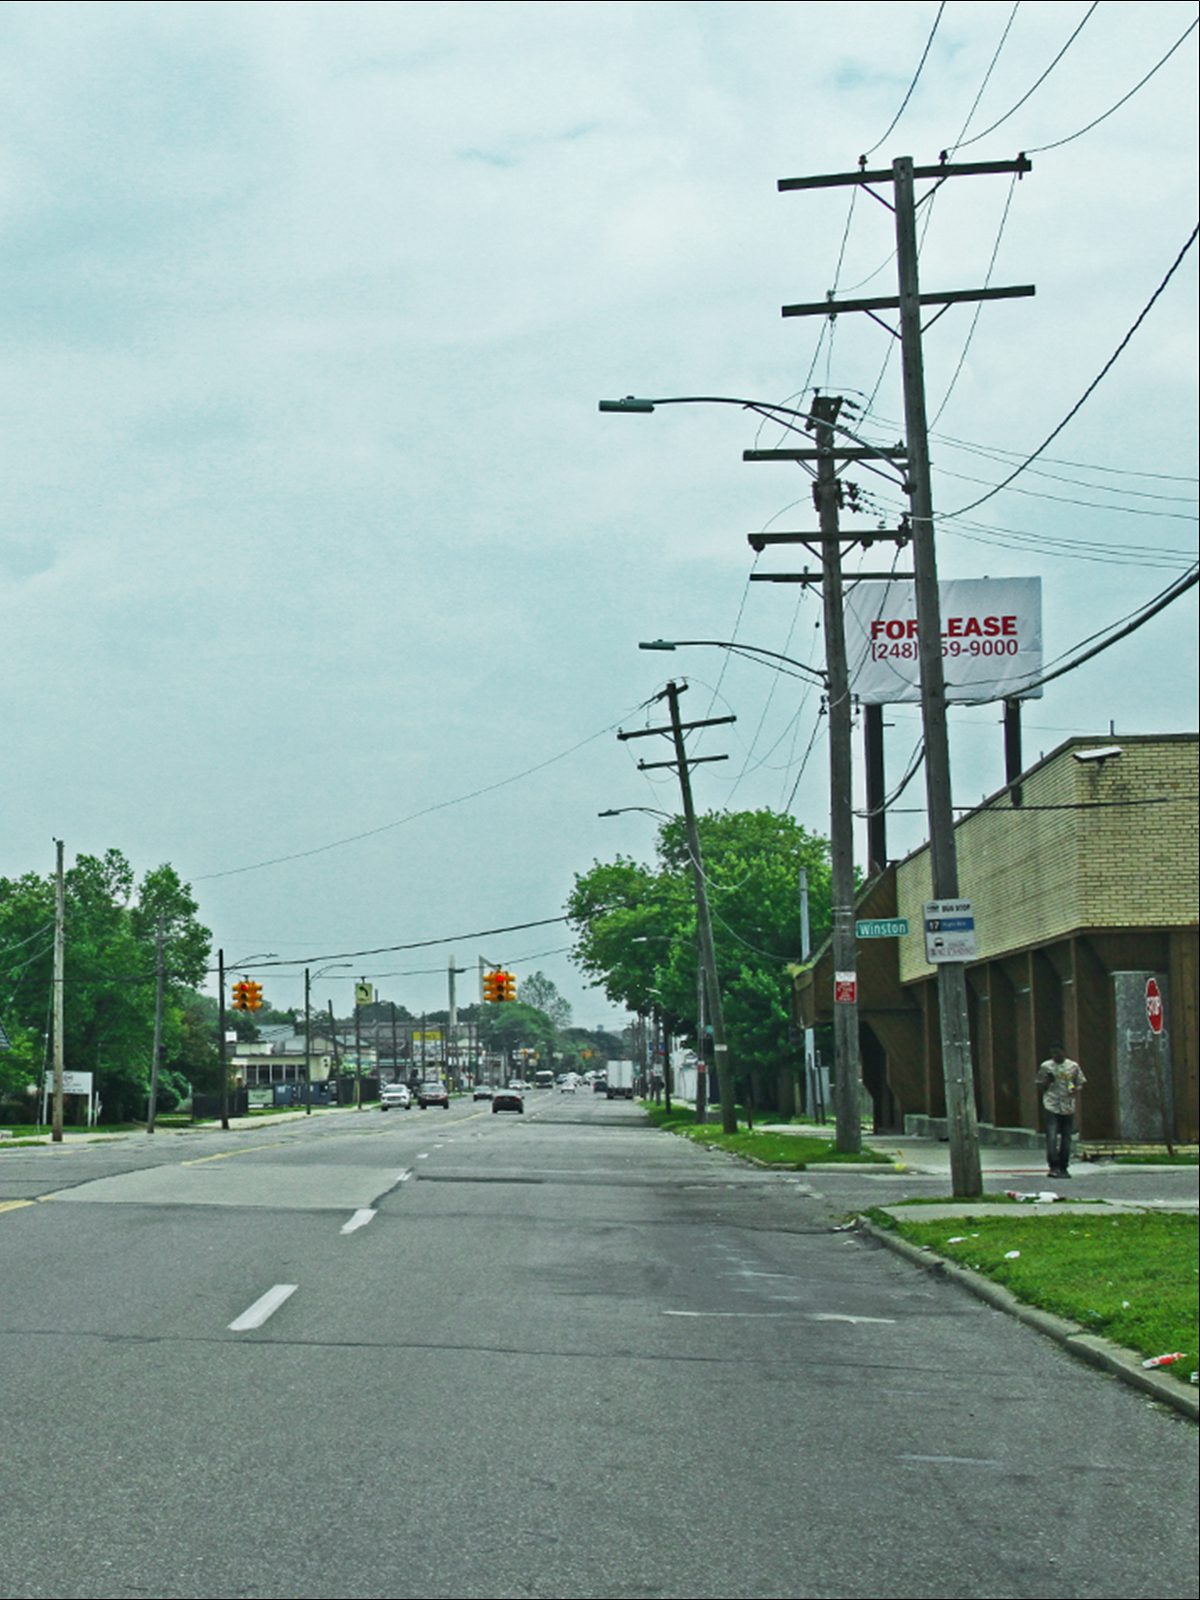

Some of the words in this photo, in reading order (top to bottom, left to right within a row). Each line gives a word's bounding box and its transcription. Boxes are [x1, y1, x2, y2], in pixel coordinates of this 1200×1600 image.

[871, 619, 918, 640] FOR
[872, 641, 918, 662] (248)
[941, 639, 1018, 658] 59-9000
[860, 921, 906, 935] Winston
[929, 920, 940, 930] 17
[1146, 996, 1161, 1016] STOP
